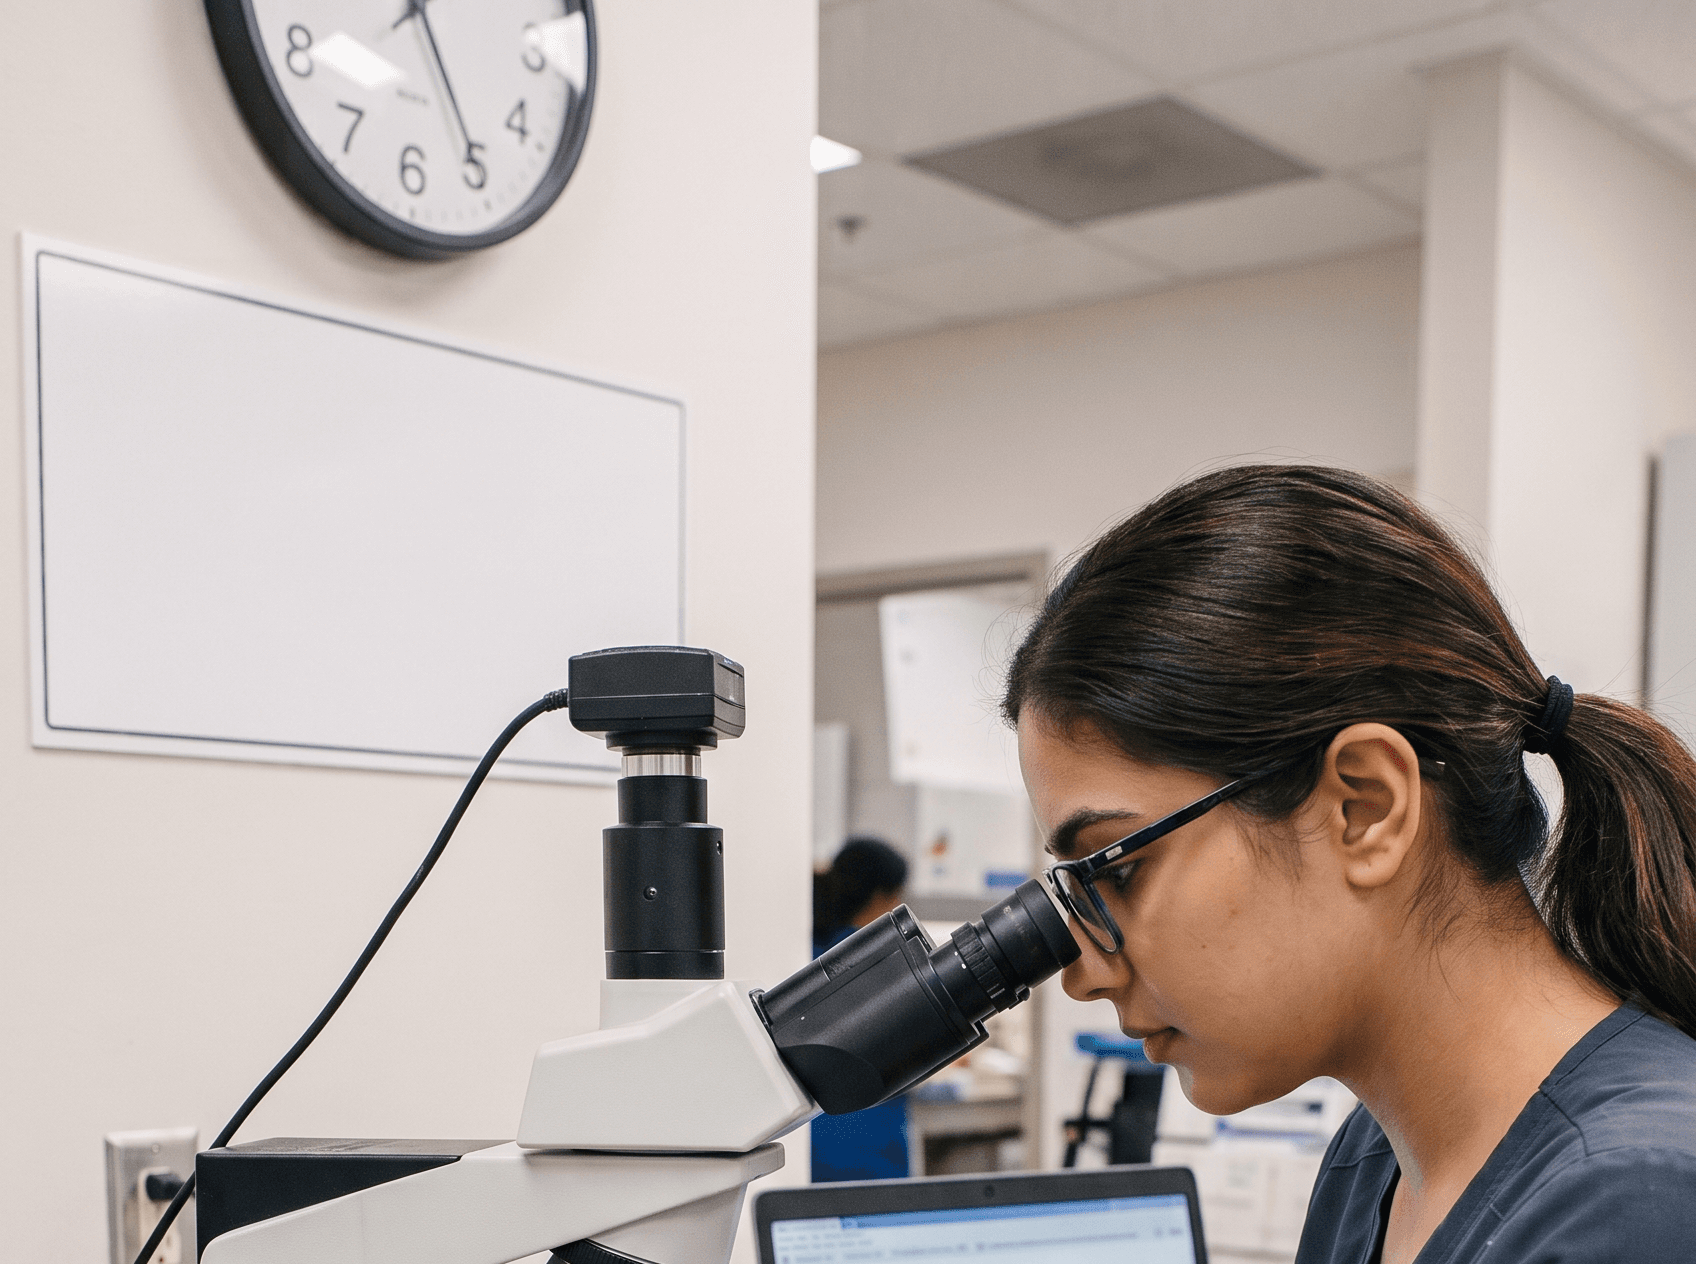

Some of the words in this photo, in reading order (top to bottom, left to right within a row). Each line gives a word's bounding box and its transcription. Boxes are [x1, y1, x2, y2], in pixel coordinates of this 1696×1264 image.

[286, 23, 314, 78] 8
[337, 102, 364, 153] 7
[505, 99, 530, 144] 4
[400, 144, 427, 195] 6
[463, 140, 488, 190] 5
